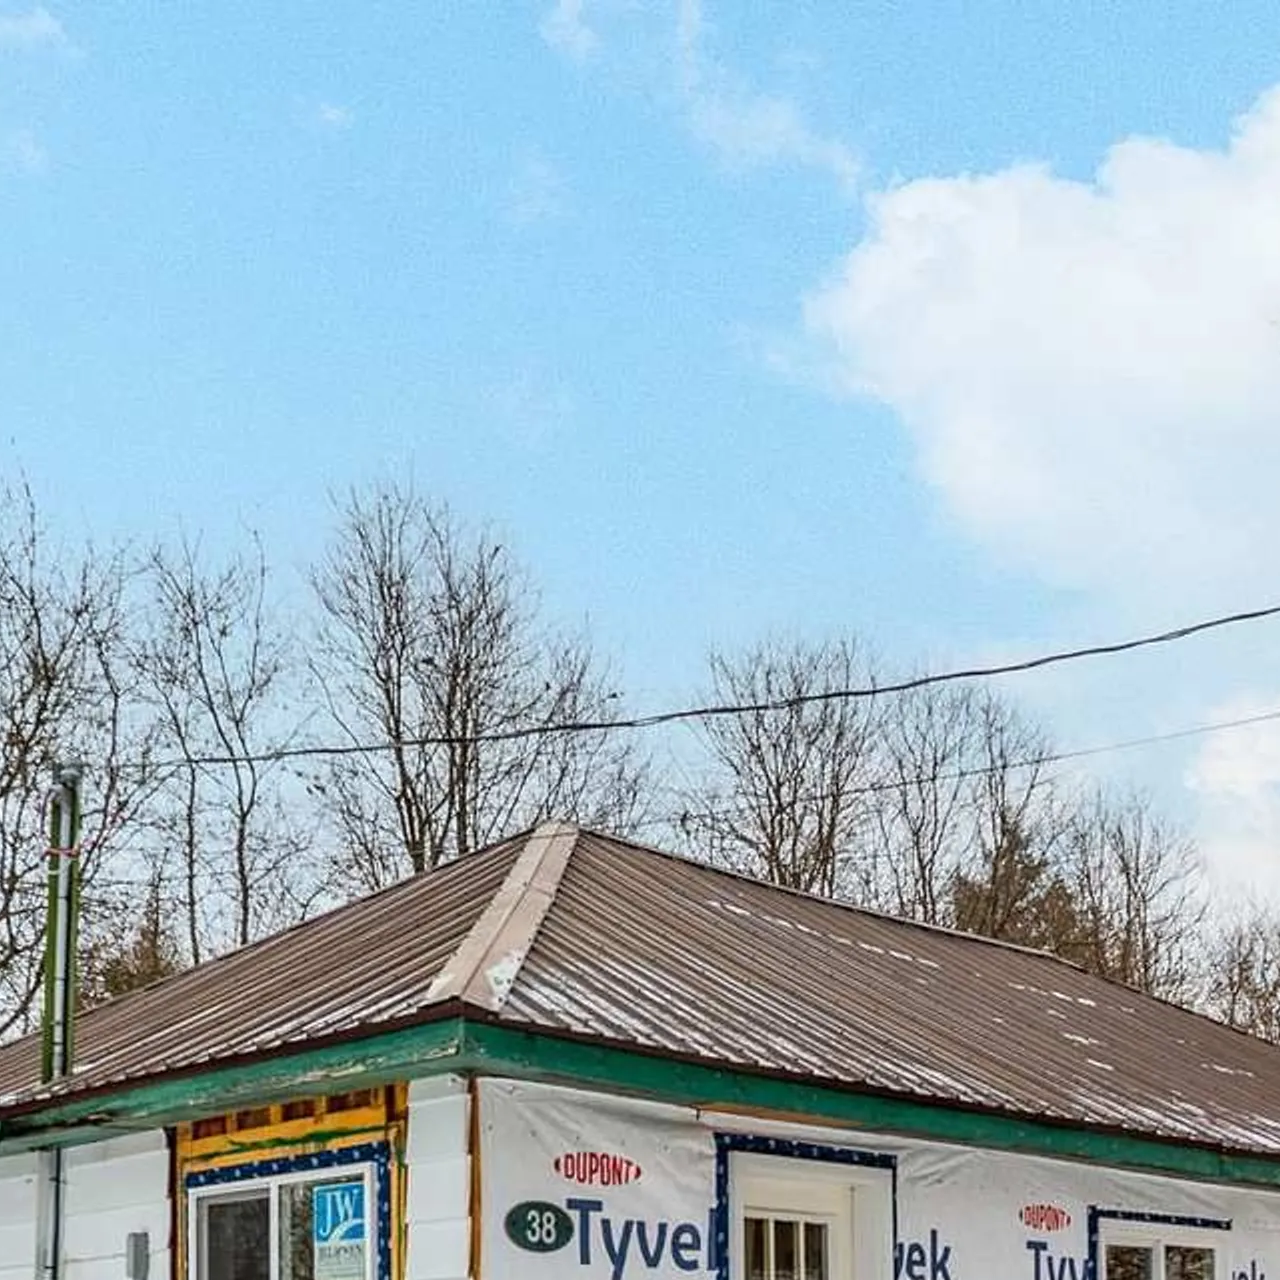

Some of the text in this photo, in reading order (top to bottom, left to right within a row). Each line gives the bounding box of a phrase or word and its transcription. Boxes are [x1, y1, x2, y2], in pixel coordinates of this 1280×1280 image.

[562, 1153, 635, 1186] DUPONT
[319, 1190, 360, 1238] JW
[527, 1209, 556, 1244] 38
